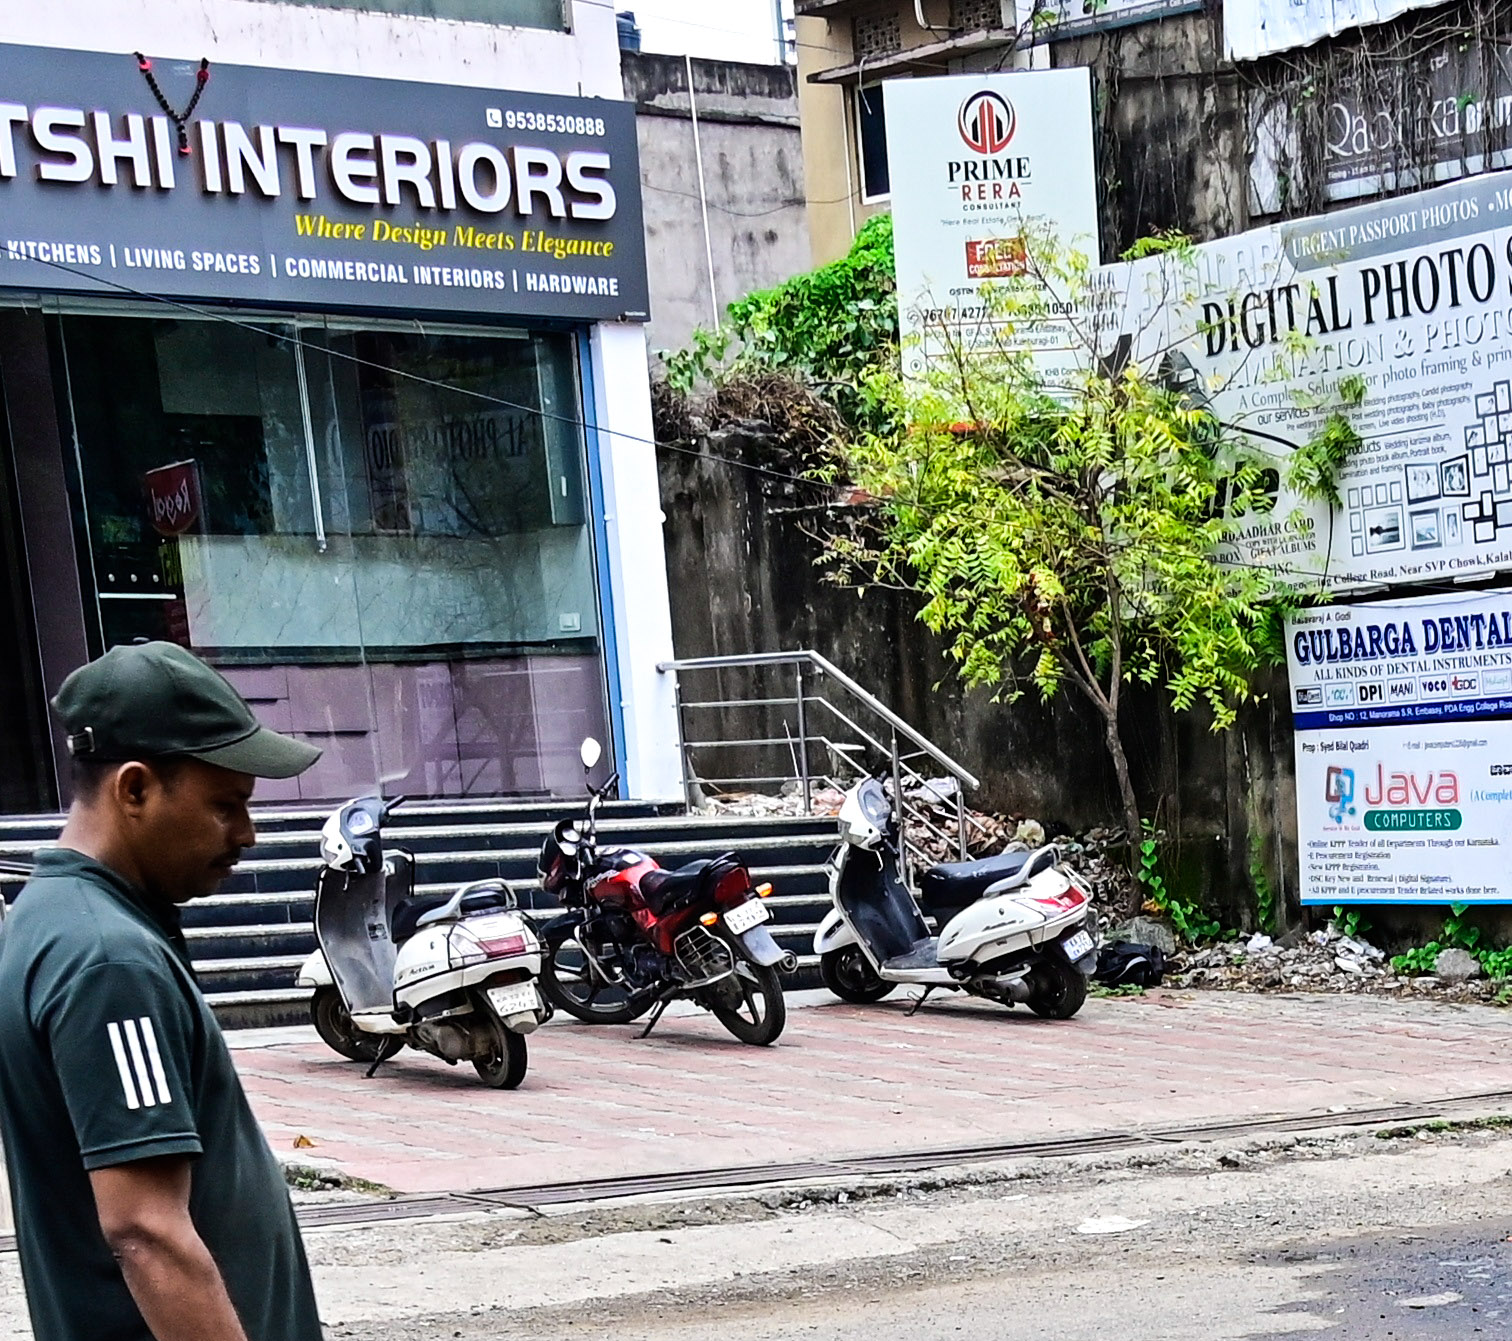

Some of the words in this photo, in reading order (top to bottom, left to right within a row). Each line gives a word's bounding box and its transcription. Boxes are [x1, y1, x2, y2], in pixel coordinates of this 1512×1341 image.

[505, 111, 605, 136] 9538530888
[199, 119, 618, 221] INTERIORS
[948, 157, 1031, 182] PRIME
[962, 181, 1021, 201] RERA
[962, 201, 1021, 212] CONSULTANT
[294, 214, 366, 241] Where
[372, 220, 446, 249] Design
[453, 226, 514, 252] Meets
[521, 230, 613, 260] Elegance
[1292, 228, 1346, 259] URGENT
[1349, 211, 1417, 246] PASSPORT
[1420, 197, 1479, 230] PHOTOS
[8, 240, 102, 266] KITCHENS
[125, 246, 186, 271] LIVING
[192, 250, 261, 275] SPACES
[286, 257, 408, 284] COMMERCIAL
[414, 265, 505, 290] INTERIORS
[526, 272, 619, 297] HARDWARE
[1203, 275, 1353, 358] DIGITAL
[1361, 240, 1496, 326] PHOTO
[1421, 354, 1468, 384] framing
[1293, 621, 1418, 665] GULBARGA
[1314, 667, 1334, 682] ALL
[1335, 665, 1368, 679] KINDS
[1387, 660, 1431, 675] DENTAL
[1433, 653, 1512, 671] INSTRUMENTS
[1359, 685, 1383, 702] DPI
[1364, 761, 1459, 807] Java
[1374, 811, 1452, 829] COMPUTERS
